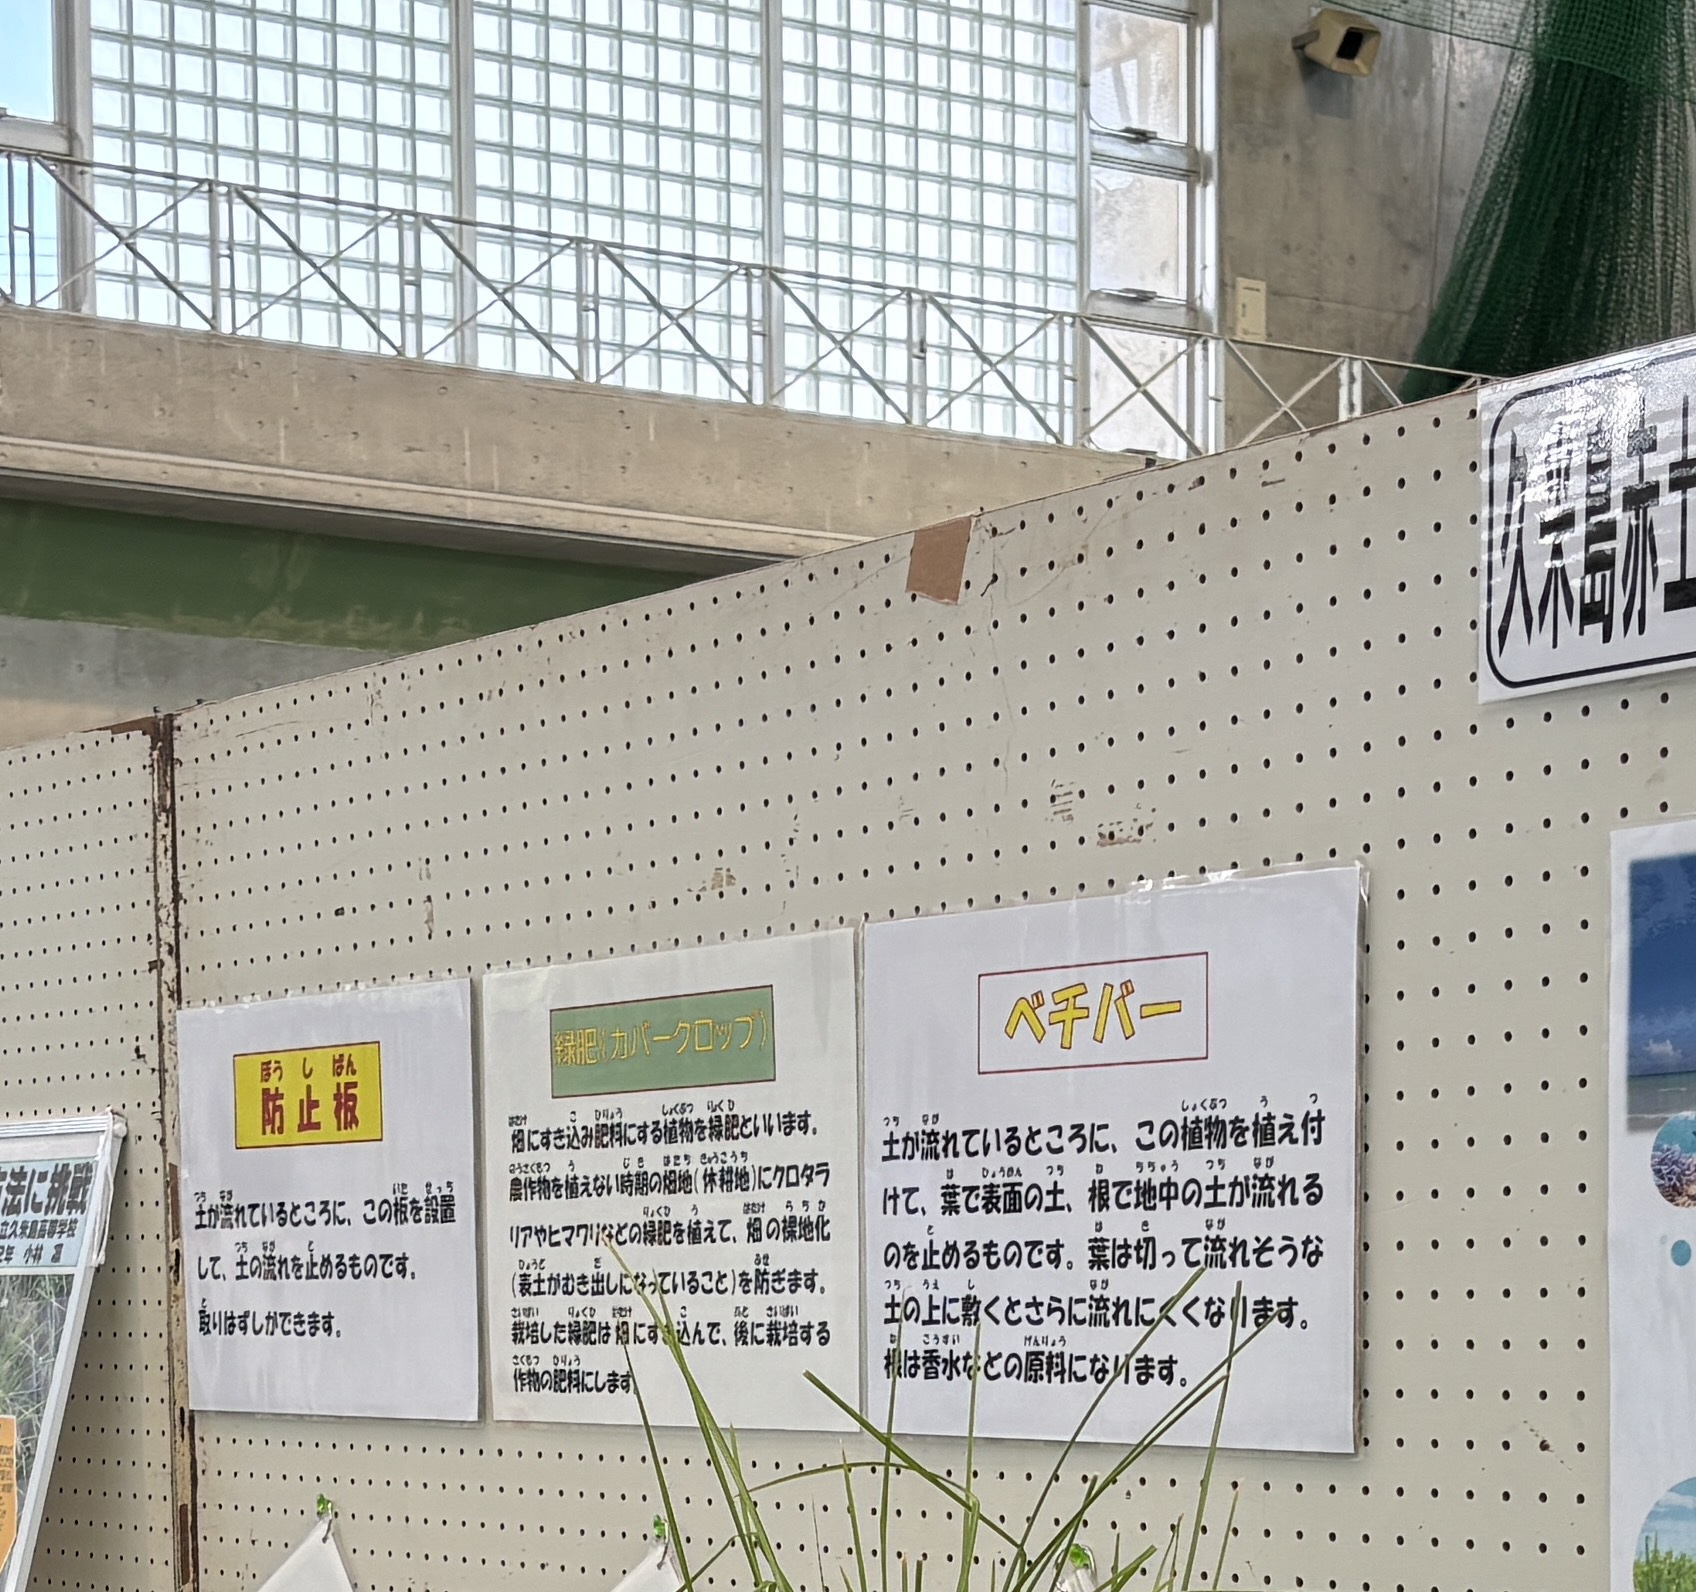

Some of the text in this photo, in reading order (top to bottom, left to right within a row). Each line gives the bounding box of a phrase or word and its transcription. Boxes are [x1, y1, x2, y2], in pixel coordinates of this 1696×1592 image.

[1003, 978, 1183, 1050] ベチバー
[260, 1081, 360, 1135] 防止板
[511, 1110, 818, 1154] 畑にすき込み肥料にする植物を緑肥といいます。
[882, 1109, 1325, 1162] 土が流れているところに、この植物を植え付
[195, 1194, 456, 1230] 土が流れているところに、この板を設置
[882, 1173, 1324, 1216] けて、葉で表面の土、根で地中の土が流れる
[197, 1252, 416, 1281] して、土の流れを止めるものです。
[883, 1235, 1324, 1271] のを止めるものです。葉は切って流れそうな
[199, 1309, 341, 1338] 取りはずしができます。
[883, 1294, 1308, 1330] 土の上に敷くとさらに流れにくくなります。
[883, 1348, 1187, 1387] 根は香水などの原料になります。
